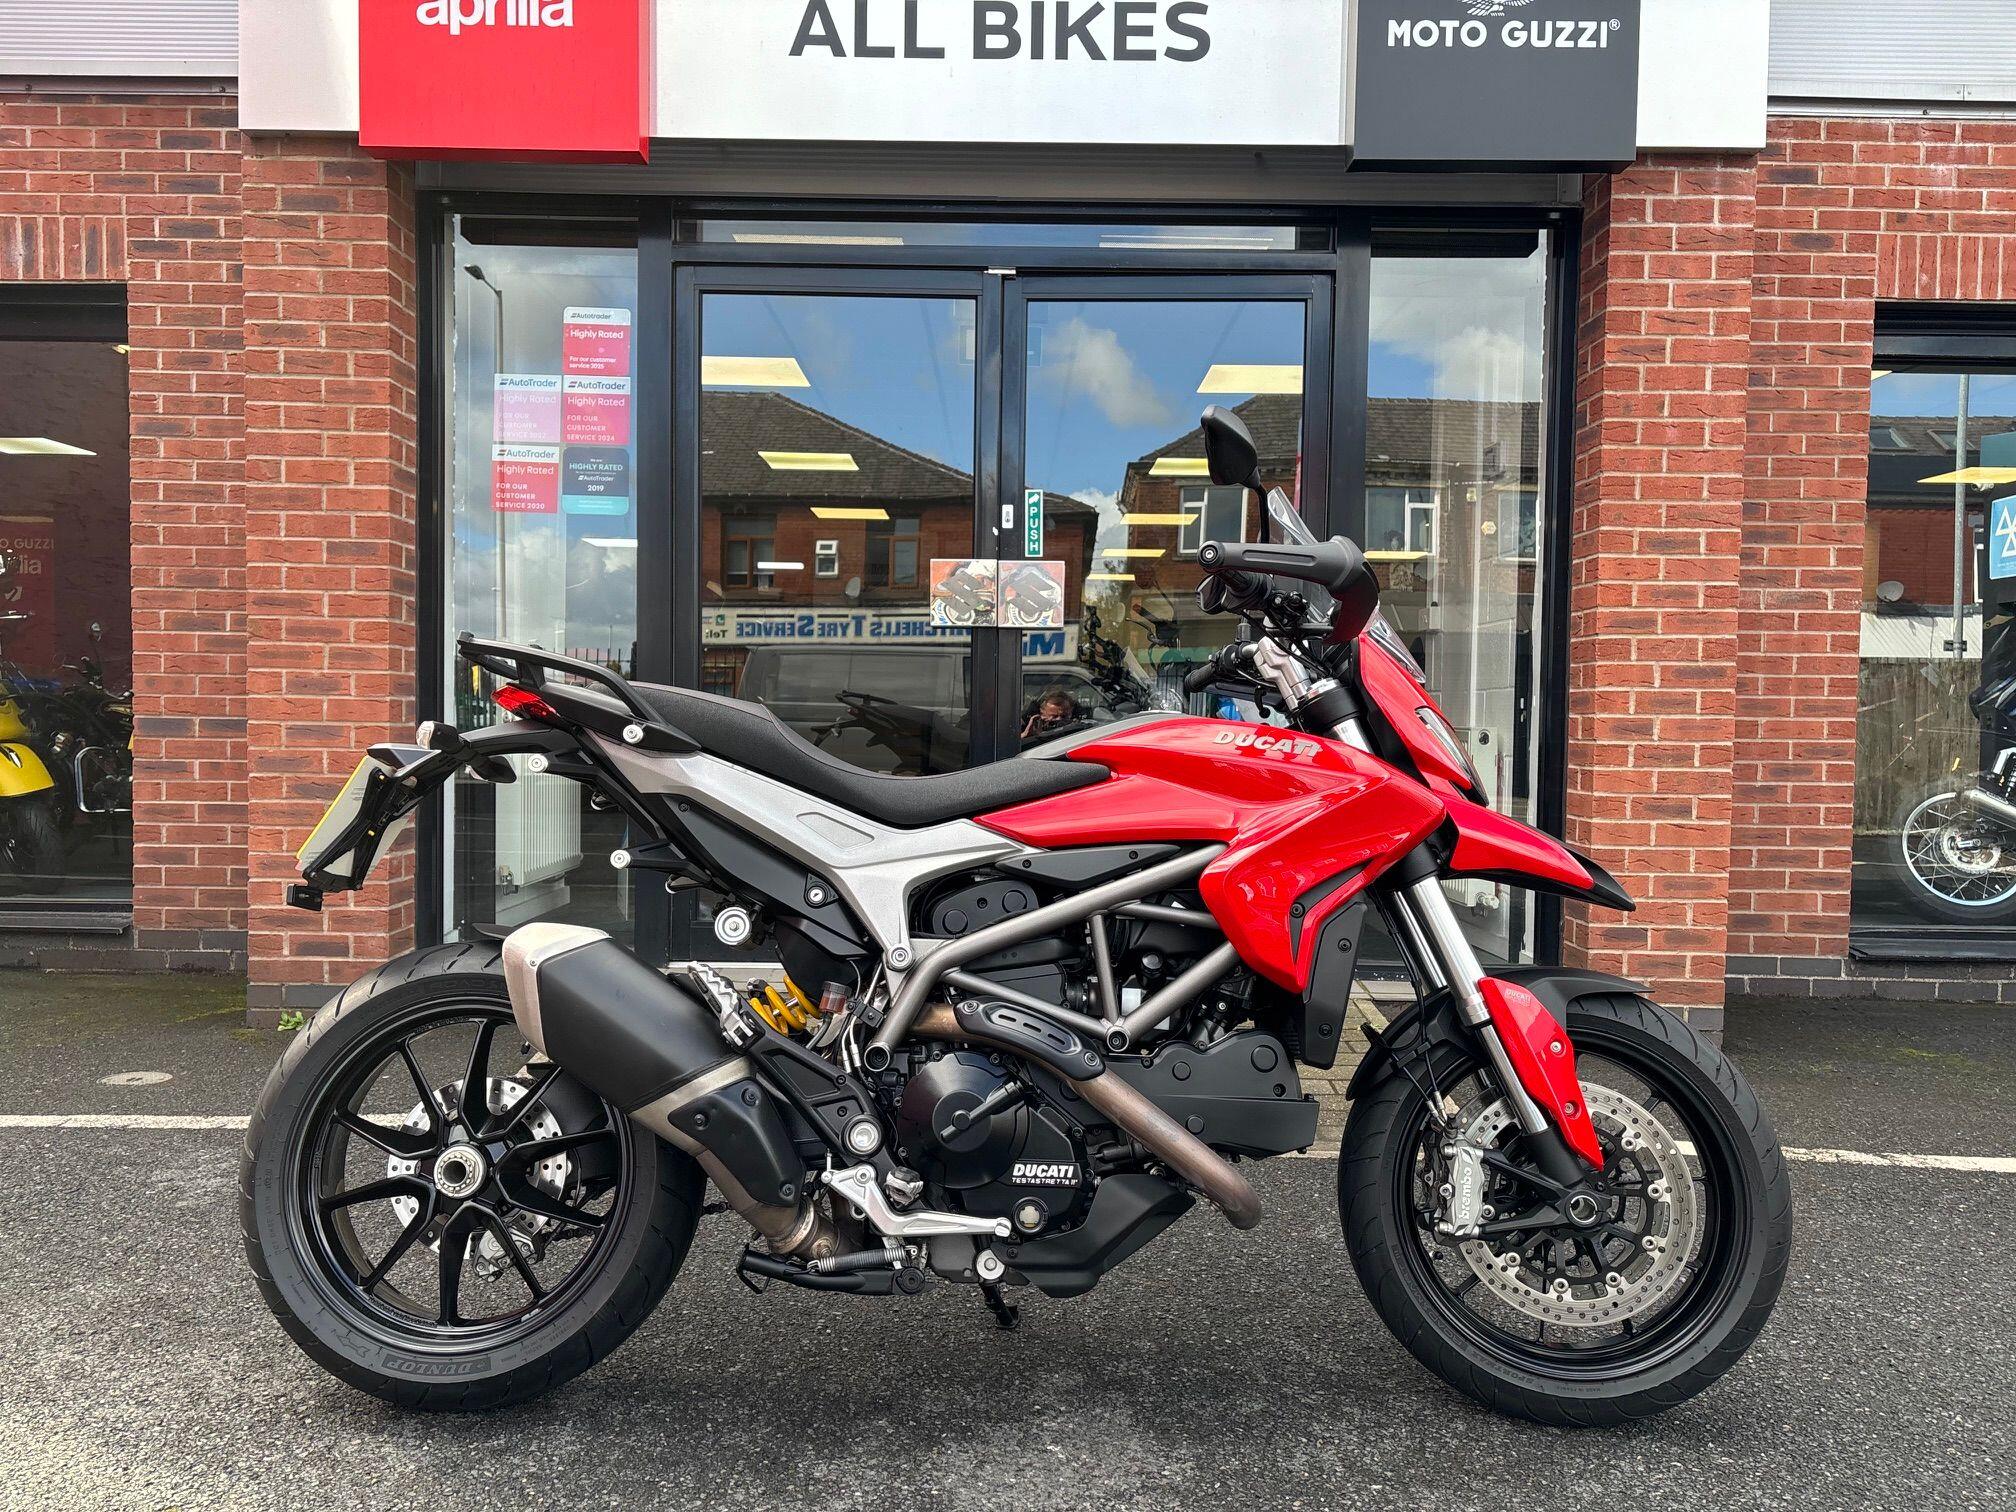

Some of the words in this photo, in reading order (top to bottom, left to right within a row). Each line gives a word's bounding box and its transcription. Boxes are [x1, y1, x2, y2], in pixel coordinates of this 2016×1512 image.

[788, 0, 945, 59] ALL
[973, 0, 1211, 63] BIKES
[1387, 19, 1488, 48] MOTO
[570, 329, 597, 341] Highly
[598, 330, 624, 339] Rated
[508, 378, 558, 387] AutoTrader
[577, 380, 626, 390] AutoTrader
[567, 396, 597, 407] Highly
[598, 397, 625, 407] Rated
[566, 433, 597, 441] SERVICE
[597, 434, 615, 442] 2024
[506, 449, 556, 459] AutoTrader
[496, 464, 525, 476] Highly
[527, 465, 554, 475] Rated
[569, 462, 597, 471] HIGHLY
[598, 463, 624, 471] RATED
[587, 484, 605, 492] 2019
[527, 502, 545, 510] 2020
[1029, 506, 1039, 552] PUSH
[14, 538, 55, 549] GUZZI
[1212, 730, 1322, 757] DUCATI
[1012, 1163, 1074, 1178] DUCATI
[1011, 1177, 1069, 1186] TESTASTRETTA
[1459, 1167, 1472, 1220] brembo
[386, 1358, 473, 1376] DUNLOP
